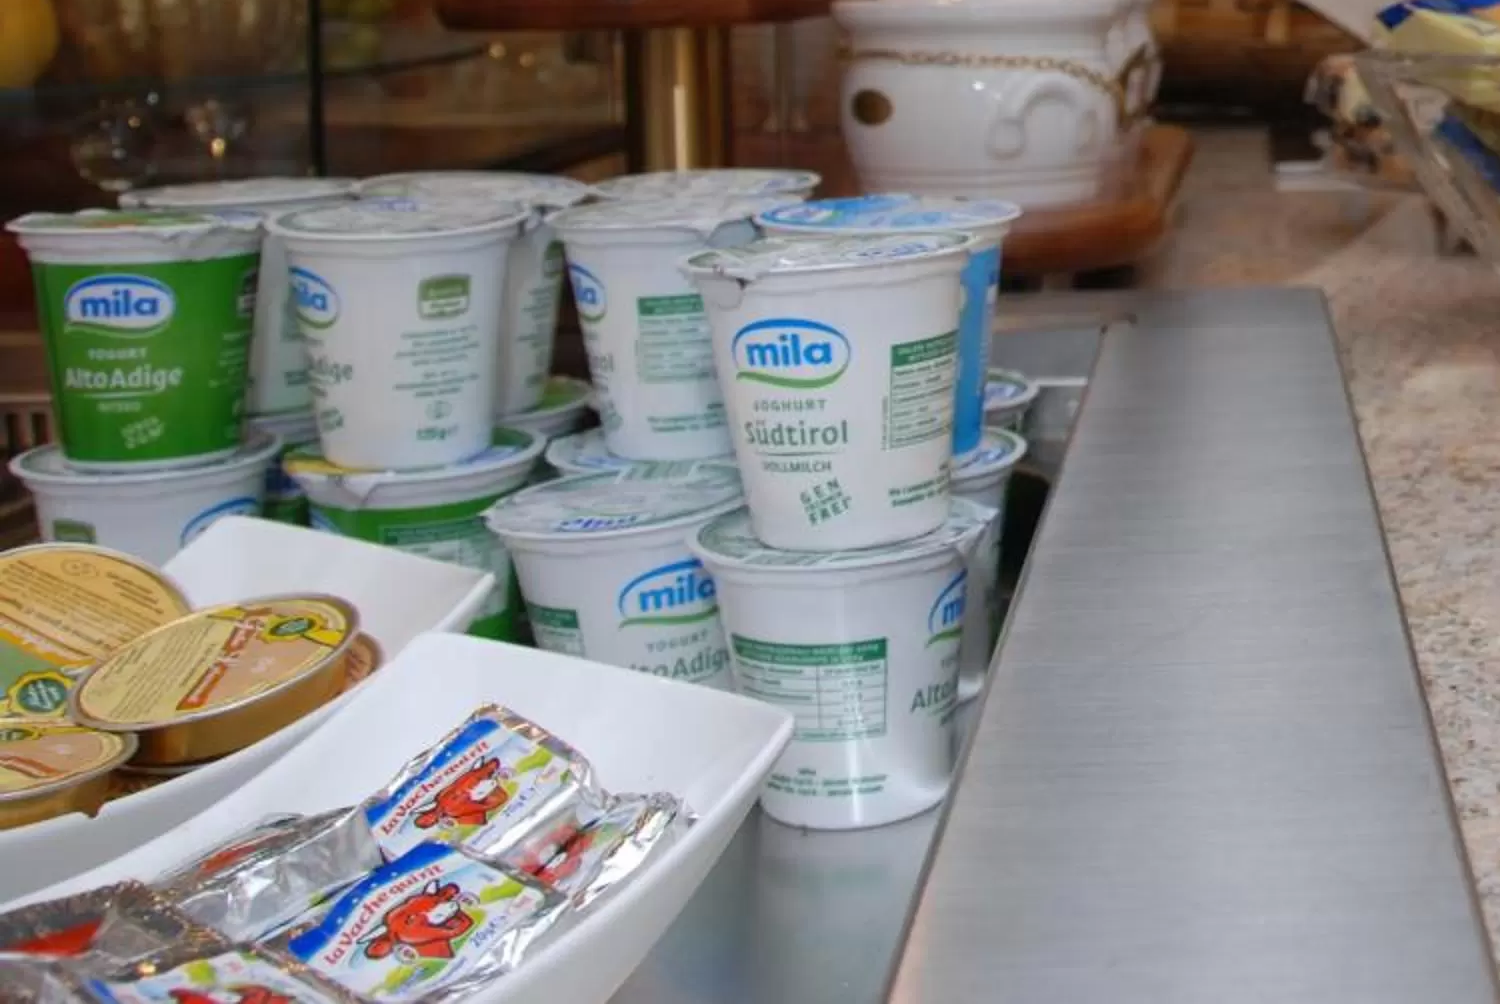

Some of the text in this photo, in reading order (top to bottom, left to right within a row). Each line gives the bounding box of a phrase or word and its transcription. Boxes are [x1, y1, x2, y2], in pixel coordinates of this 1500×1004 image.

[80, 289, 159, 317] mila
[87, 347, 148, 361] YOGURT
[745, 333, 833, 367] mila
[65, 365, 183, 392] AltoAdige
[753, 398, 828, 413] JOGHURT
[744, 418, 848, 446] Südtirol
[764, 459, 832, 474] VOLLMILCH
[800, 478, 840, 504] GEN
[339, 890, 391, 946] Vache
